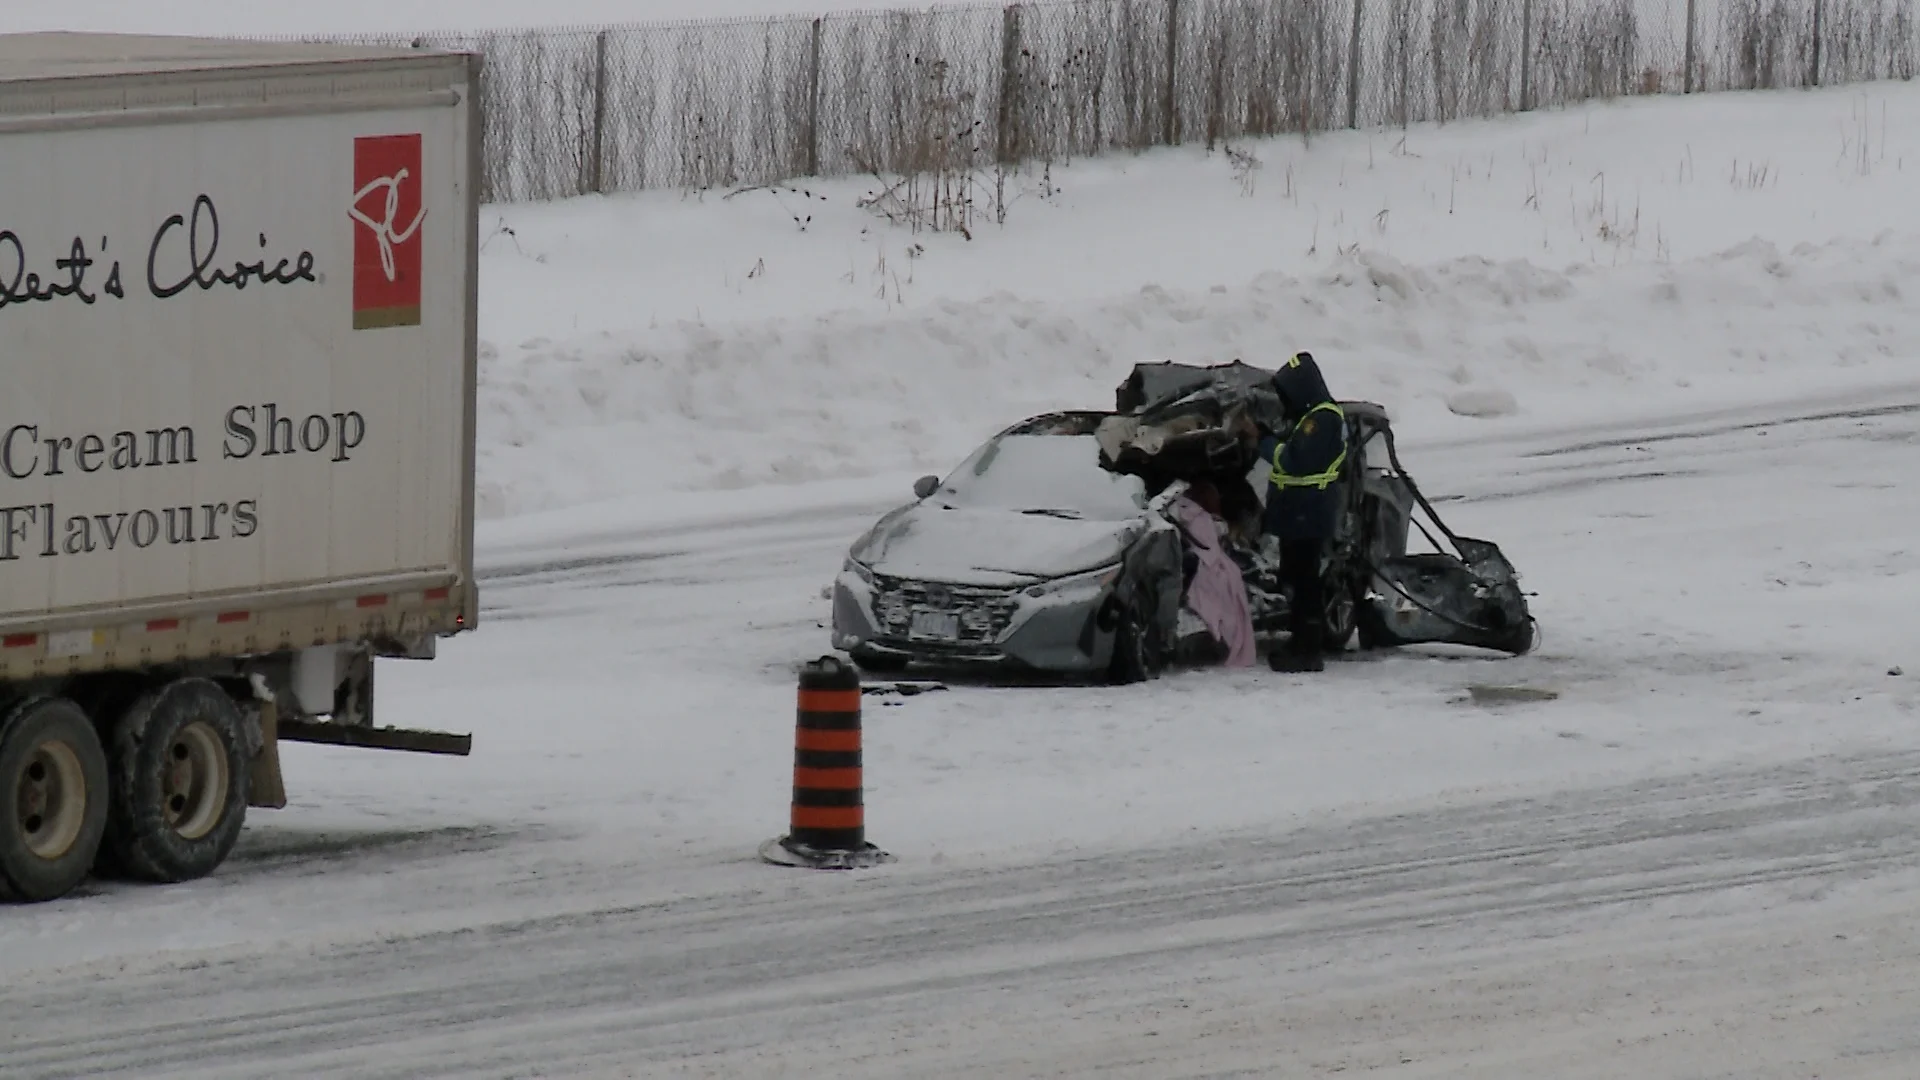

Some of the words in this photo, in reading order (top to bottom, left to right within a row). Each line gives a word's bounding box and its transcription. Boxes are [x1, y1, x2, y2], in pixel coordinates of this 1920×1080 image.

[147, 194, 316, 298] Choice
[1, 424, 198, 479] Cream
[222, 403, 366, 462] Shop
[0, 499, 258, 560] Flavours
